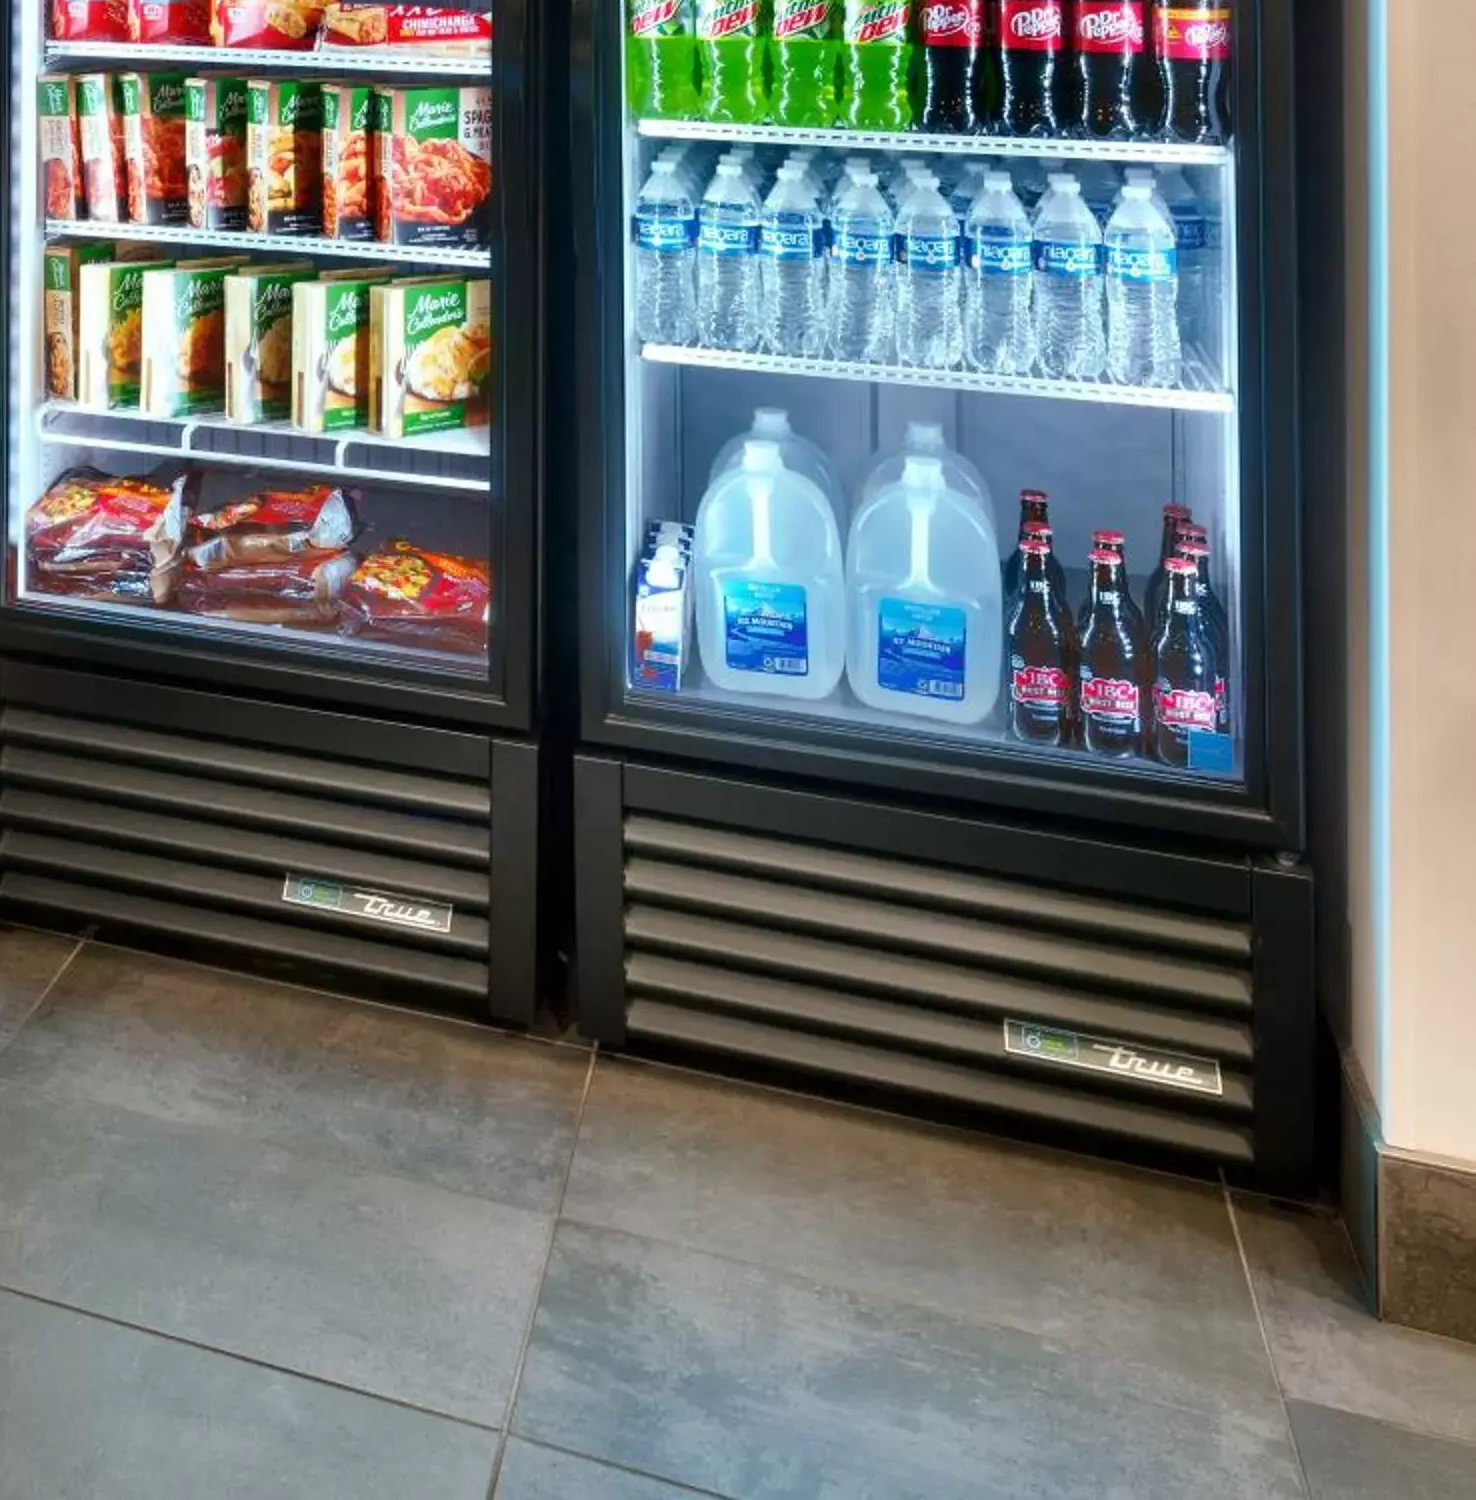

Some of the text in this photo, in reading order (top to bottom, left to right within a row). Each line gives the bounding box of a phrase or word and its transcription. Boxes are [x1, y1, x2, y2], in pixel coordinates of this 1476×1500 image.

[412, 100, 454, 118] Marie
[1042, 243, 1096, 263] niagara
[411, 291, 462, 314] Marie
[1029, 672, 1060, 686] IBC
[1097, 683, 1130, 698] IBC
[352, 891, 436, 925] True
[1091, 1042, 1203, 1086] True
